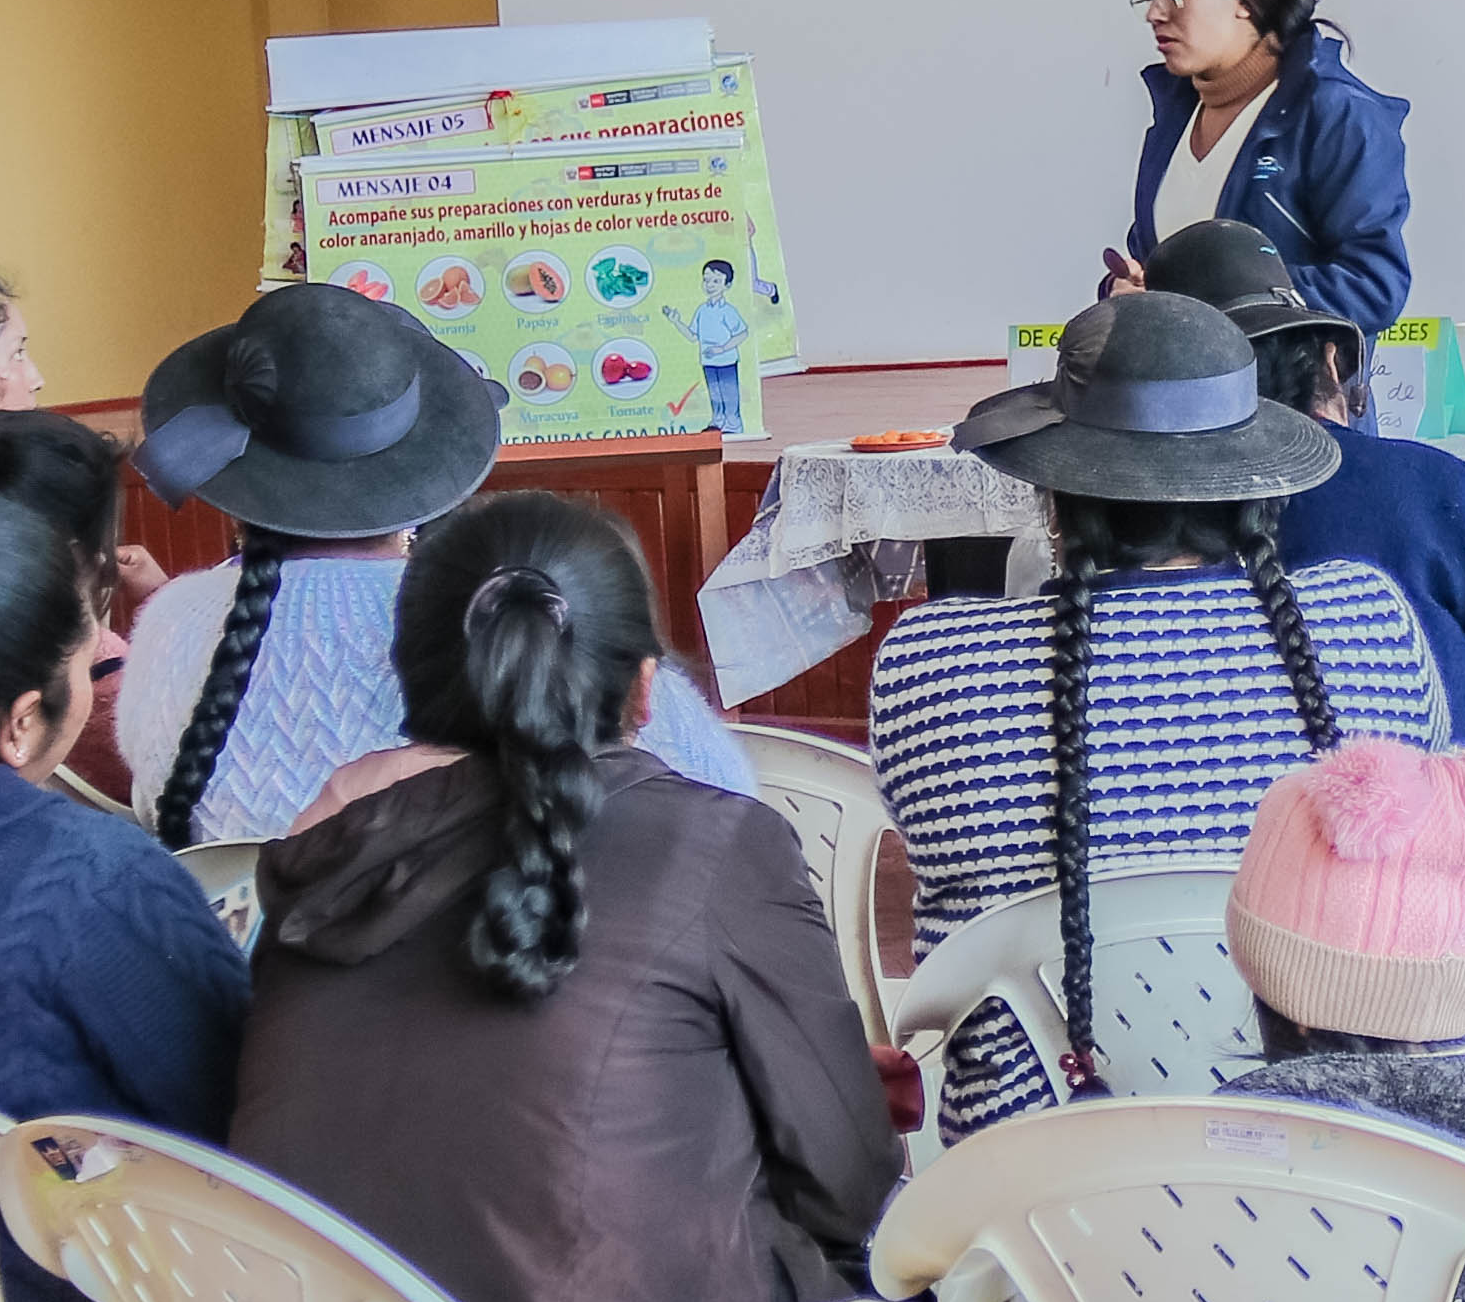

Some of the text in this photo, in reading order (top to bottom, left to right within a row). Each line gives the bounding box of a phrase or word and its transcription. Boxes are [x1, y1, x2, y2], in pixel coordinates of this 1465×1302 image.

[352, 113, 465, 147] MENSAJE 05
[337, 174, 453, 198] MENSAJE 04
[329, 183, 722, 228] Acompañe sus preparaciones con verduras y frutas de
[319, 208, 735, 249] color anaranjado, amarillo y hojas de color verde oscuro.
[516, 317, 559, 331] Papaya
[597, 313, 651, 327] Espinaca
[1019, 329, 1043, 347] DE
[1387, 382, 1415, 401] de
[608, 404, 655, 418] Tomate
